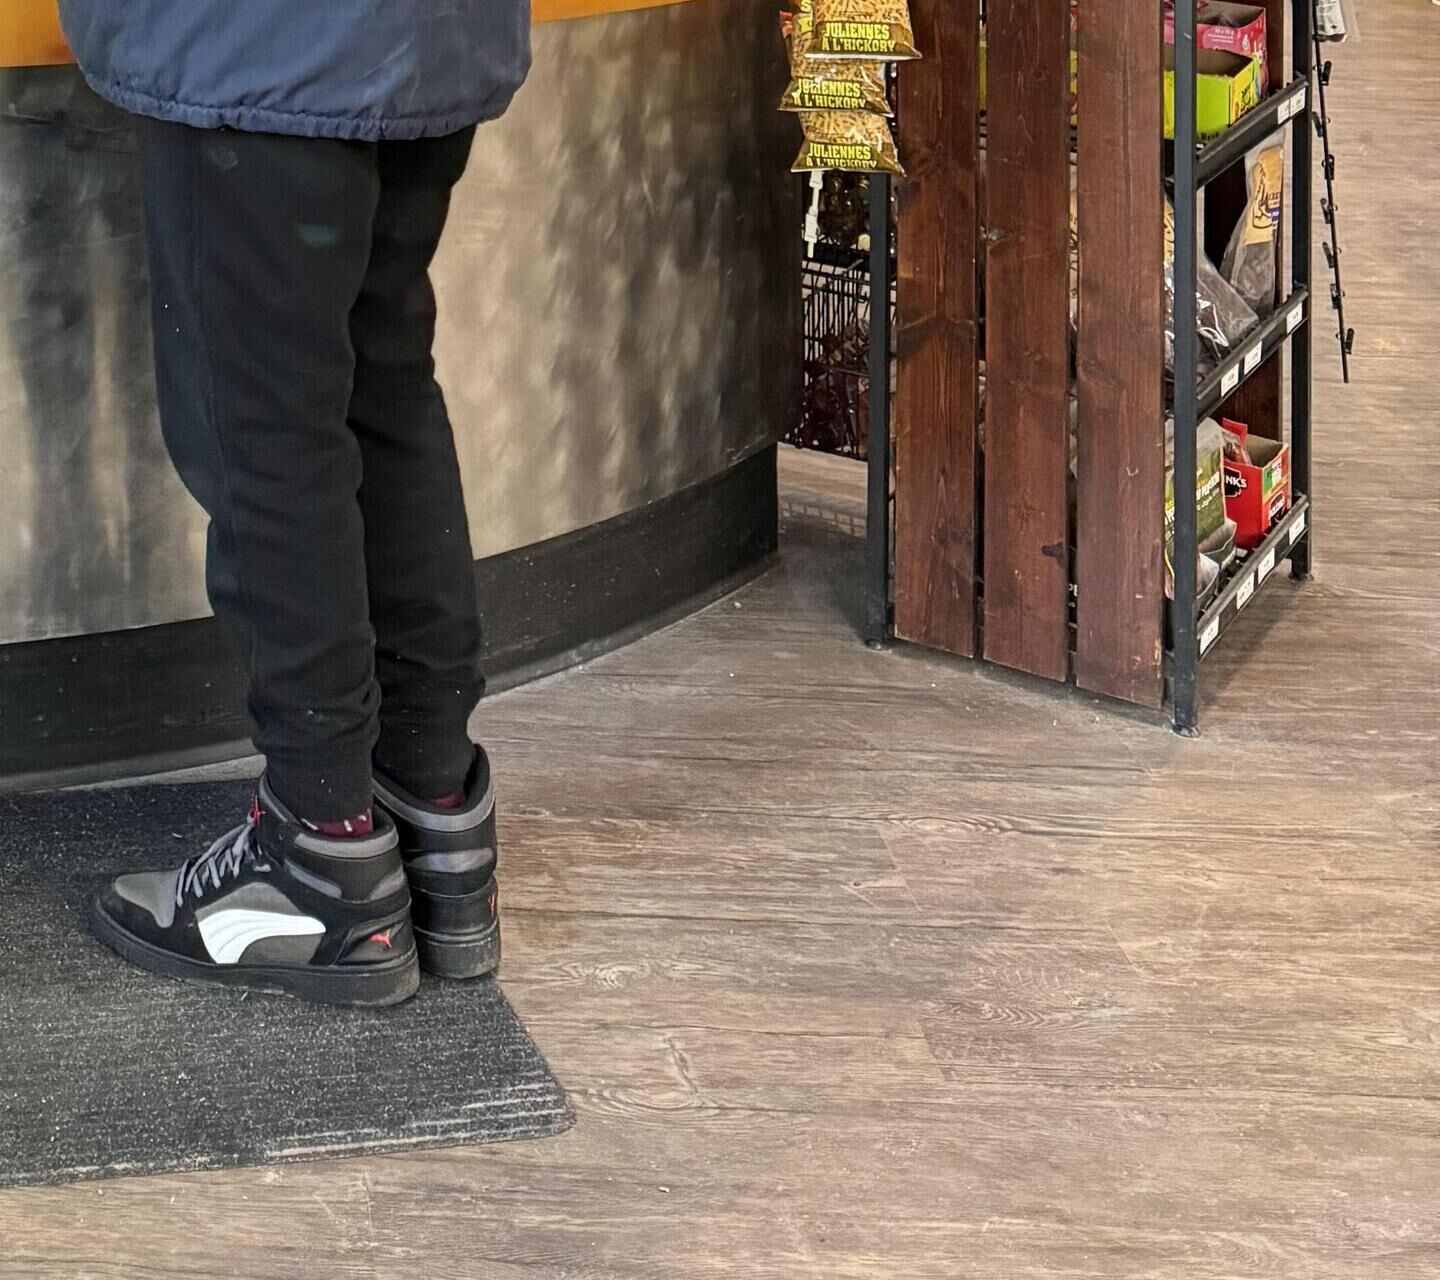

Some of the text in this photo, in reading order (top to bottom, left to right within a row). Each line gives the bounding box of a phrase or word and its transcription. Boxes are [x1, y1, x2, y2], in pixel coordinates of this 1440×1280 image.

[824, 22, 890, 40] JULIENNES
[832, 39, 896, 53] L'HICKORY
[797, 79, 860, 97] JULIENNES
[803, 94, 866, 109] L'HICKORY
[809, 142, 872, 159] JULIENNES
